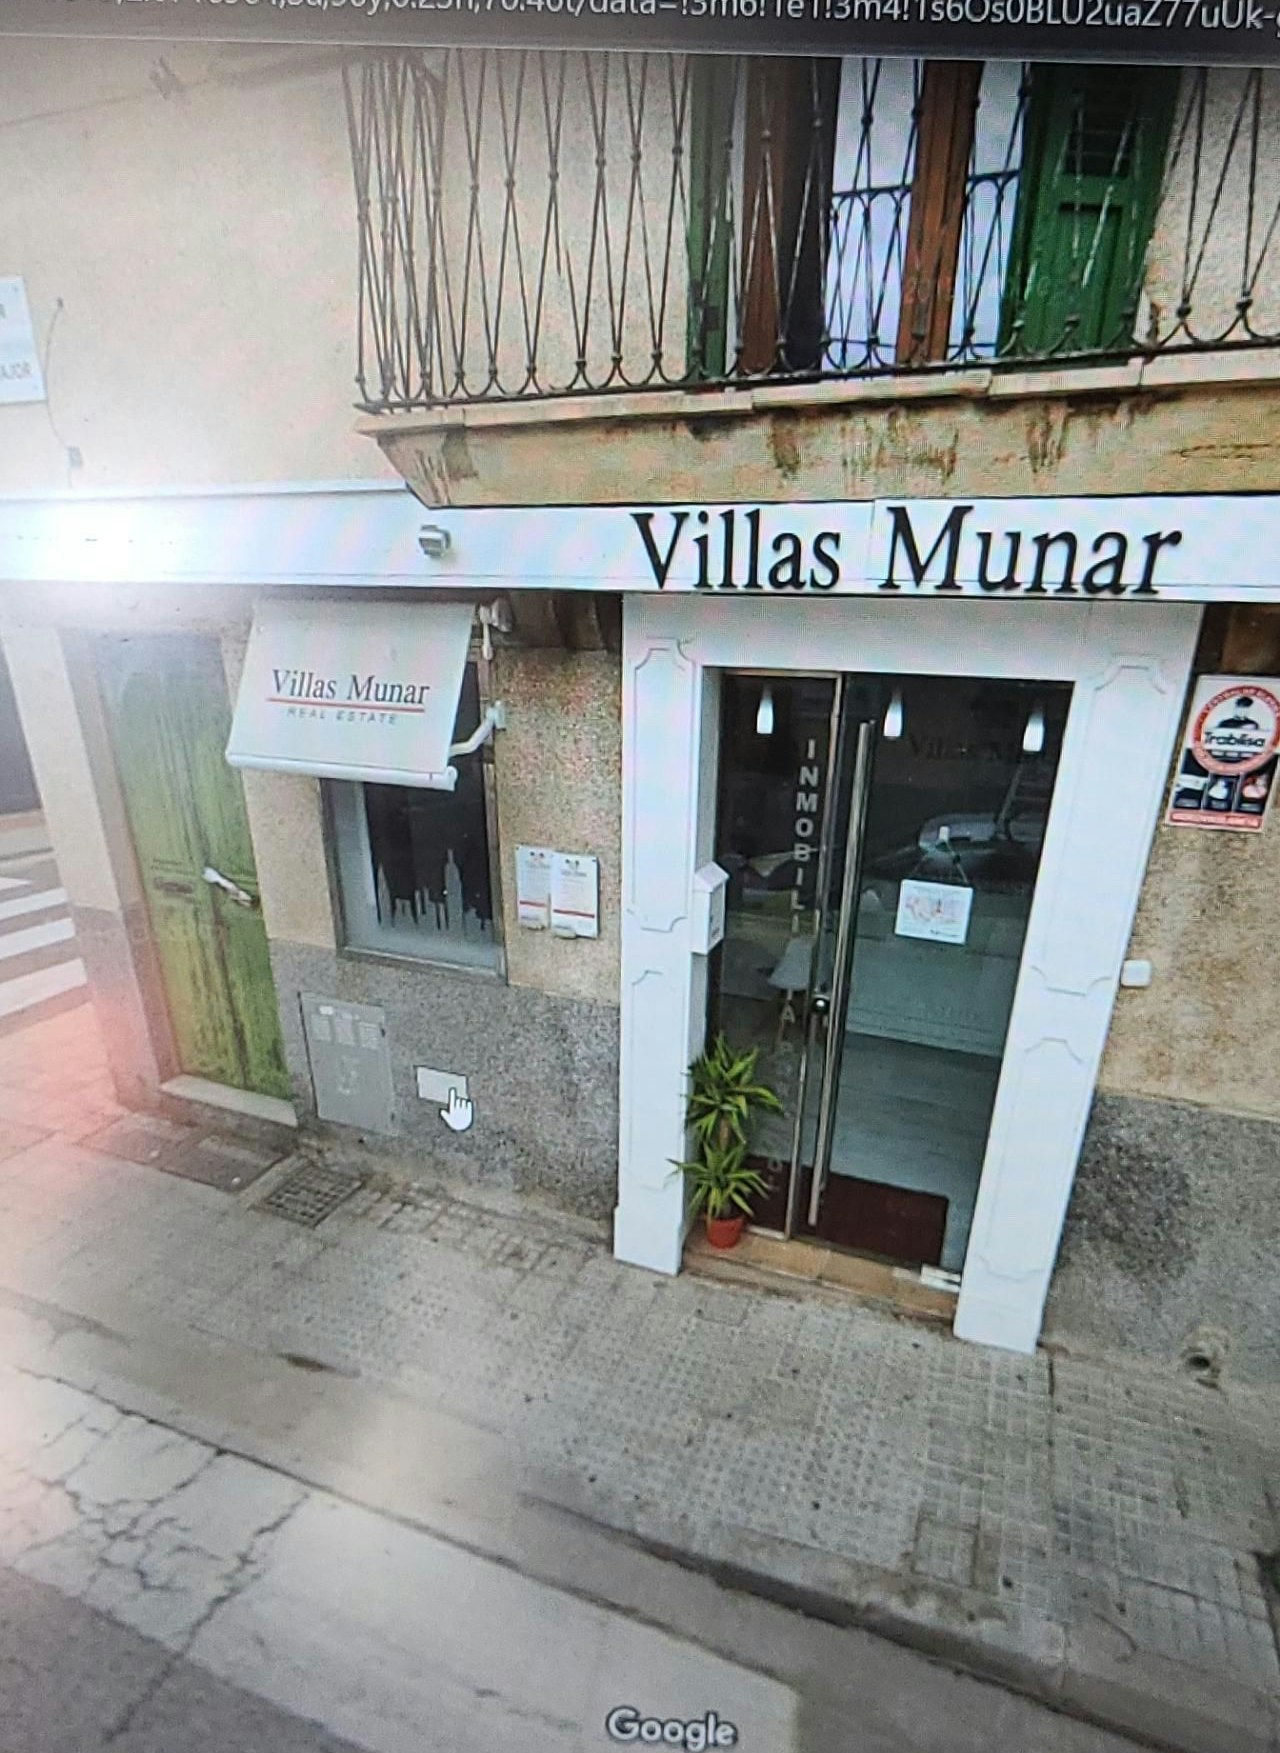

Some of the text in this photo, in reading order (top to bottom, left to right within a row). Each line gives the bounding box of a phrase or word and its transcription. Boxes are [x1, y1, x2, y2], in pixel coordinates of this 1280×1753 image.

[631, 504, 1183, 596] Villas Munar
[272, 668, 431, 706] Villas Munar
[286, 706, 398, 726] REAL ESTATE
[605, 1706, 739, 1751] Google
